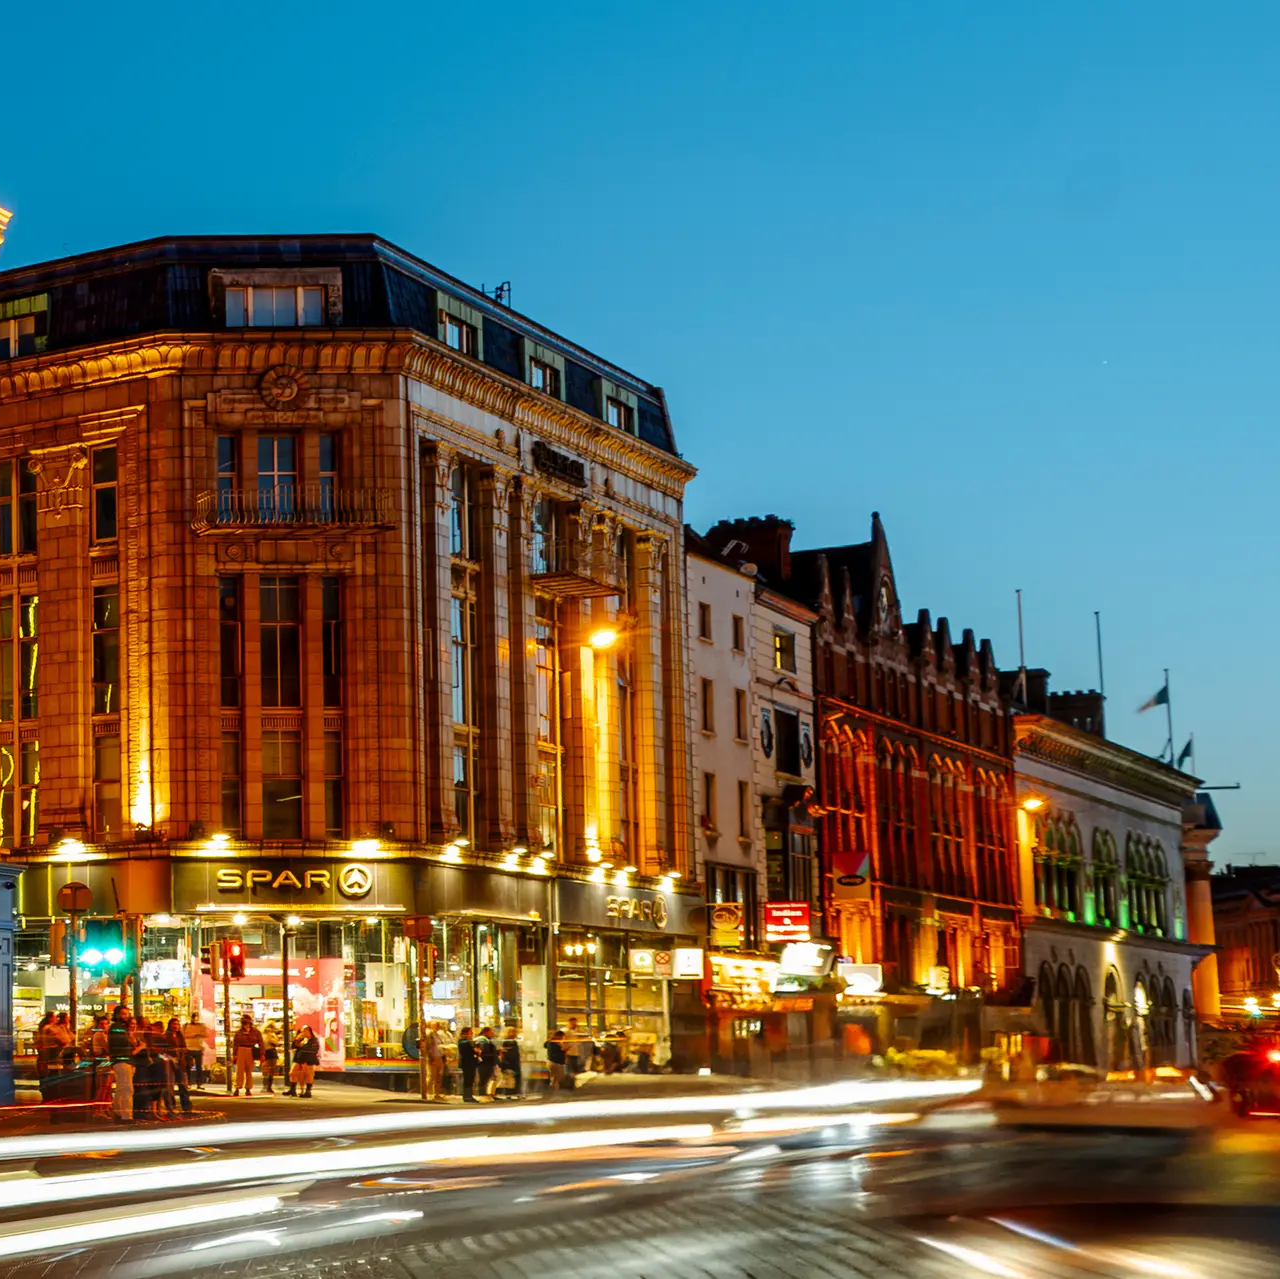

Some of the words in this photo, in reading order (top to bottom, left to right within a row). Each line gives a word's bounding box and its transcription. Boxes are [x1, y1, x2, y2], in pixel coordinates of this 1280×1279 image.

[217, 869, 331, 889] SPAR
[607, 895, 653, 921] SPAR
[93, 1003, 103, 1011] to
